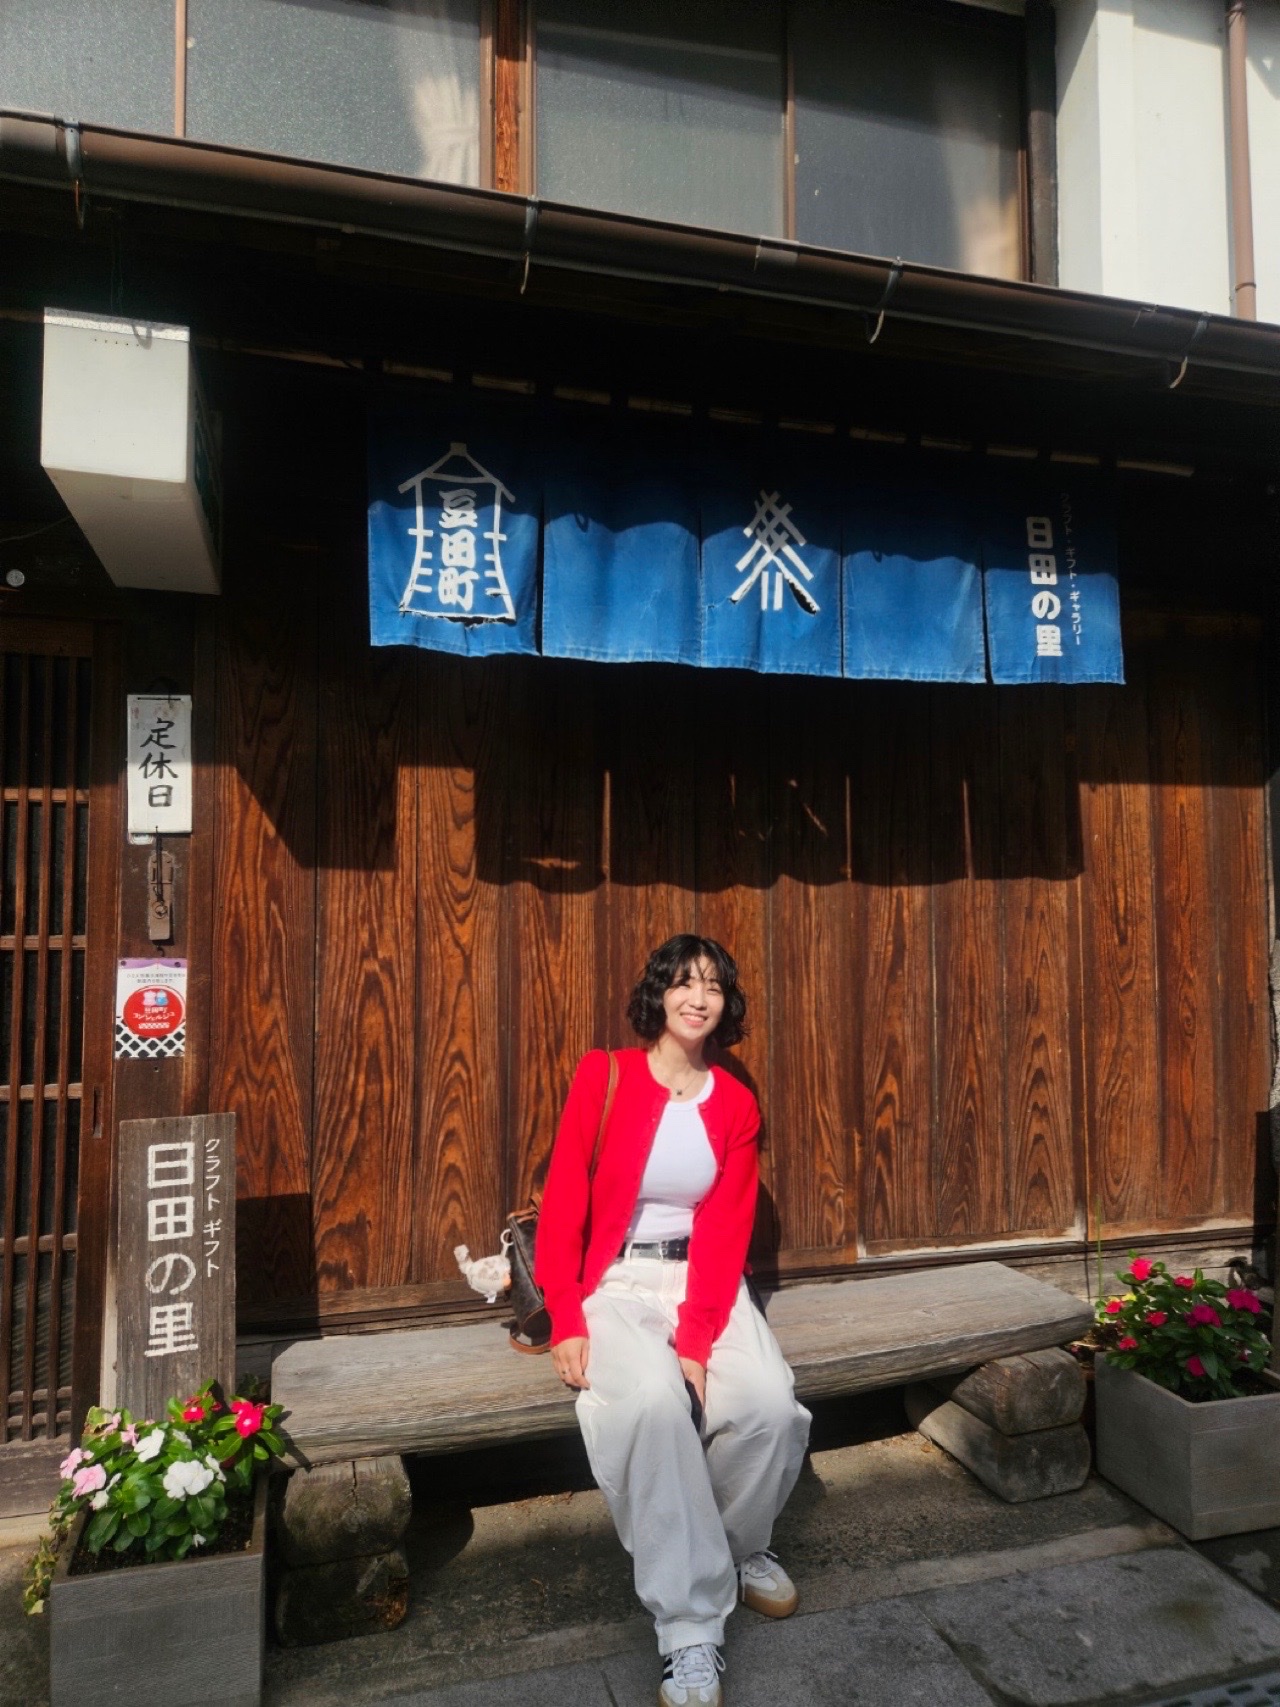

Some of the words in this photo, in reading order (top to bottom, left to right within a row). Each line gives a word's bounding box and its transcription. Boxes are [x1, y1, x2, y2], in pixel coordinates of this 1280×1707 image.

[438, 488, 480, 612] 豆田町
[1026, 516, 1063, 657] 日田の里
[138, 717, 179, 808] 定休日
[204, 1138, 221, 1212] クラフト
[144, 1141, 199, 1358] 日田の里
[203, 1218, 223, 1278] ギフト
